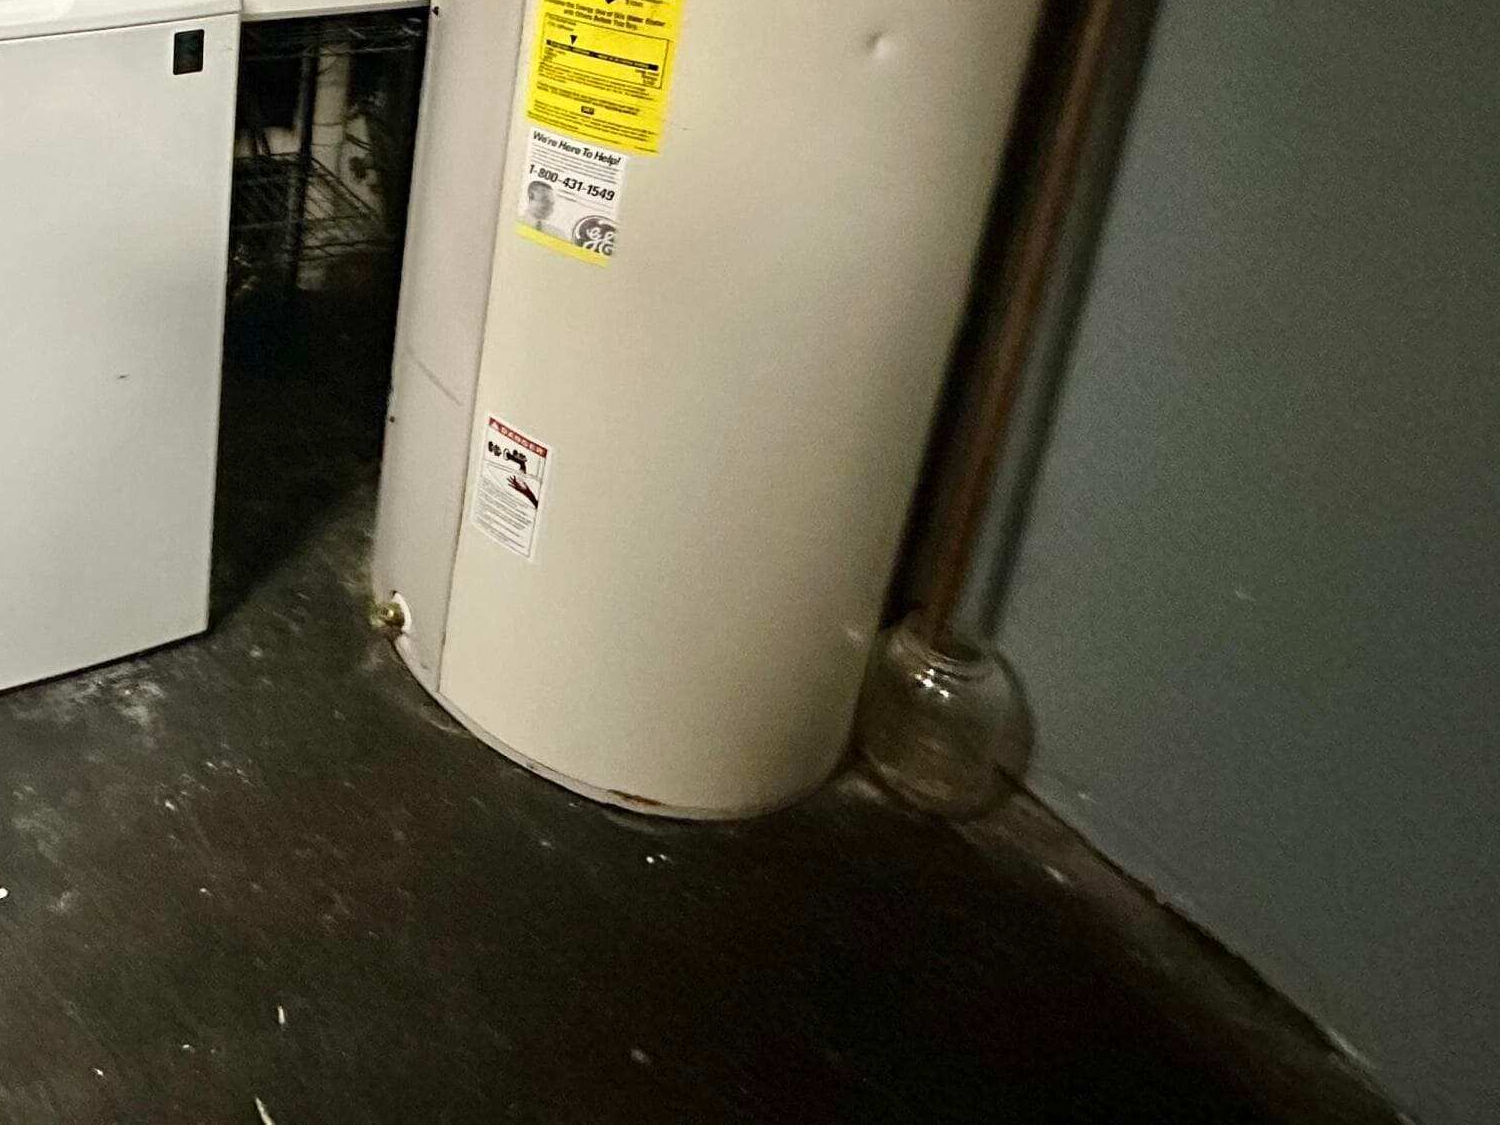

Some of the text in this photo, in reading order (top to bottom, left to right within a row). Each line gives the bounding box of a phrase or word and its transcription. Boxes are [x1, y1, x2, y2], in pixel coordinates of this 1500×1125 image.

[532, 130, 622, 167] We're Here To Help!
[528, 164, 616, 201] 1-800-431-1549
